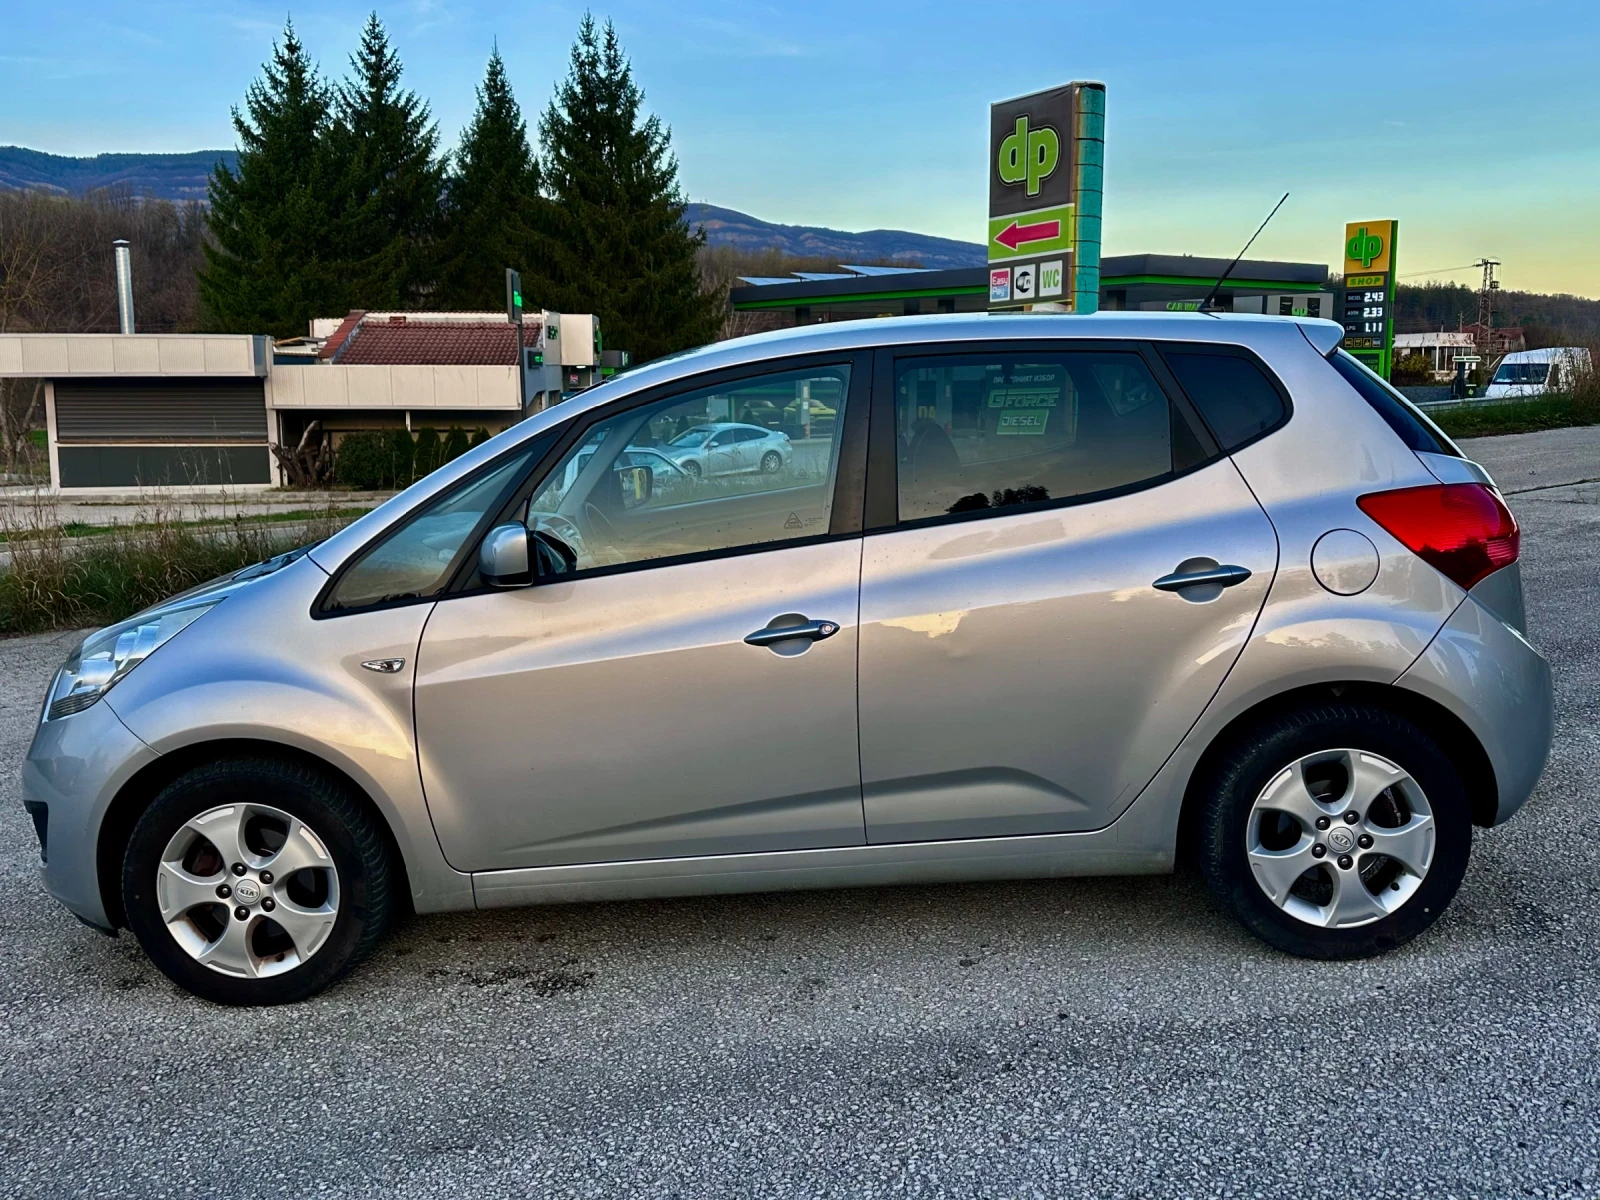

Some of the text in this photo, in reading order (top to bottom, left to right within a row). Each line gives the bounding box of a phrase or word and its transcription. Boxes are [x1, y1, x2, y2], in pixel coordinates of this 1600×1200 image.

[998, 115, 1060, 196] dp
[1347, 227, 1382, 268] dp
[992, 276, 1008, 287] Easy
[1042, 269, 1060, 289] WC
[1350, 277, 1381, 286] SHOP
[992, 287, 1005, 297] Pay
[1364, 292, 1384, 302] 2.43
[1166, 302, 1183, 311] CAR
[1363, 307, 1383, 318] 2.33
[1365, 322, 1383, 333] 1.11
[1001, 416, 1041, 426] DIESEL
[1335, 834, 1348, 846] KIA
[240, 888, 254, 896] KIA
